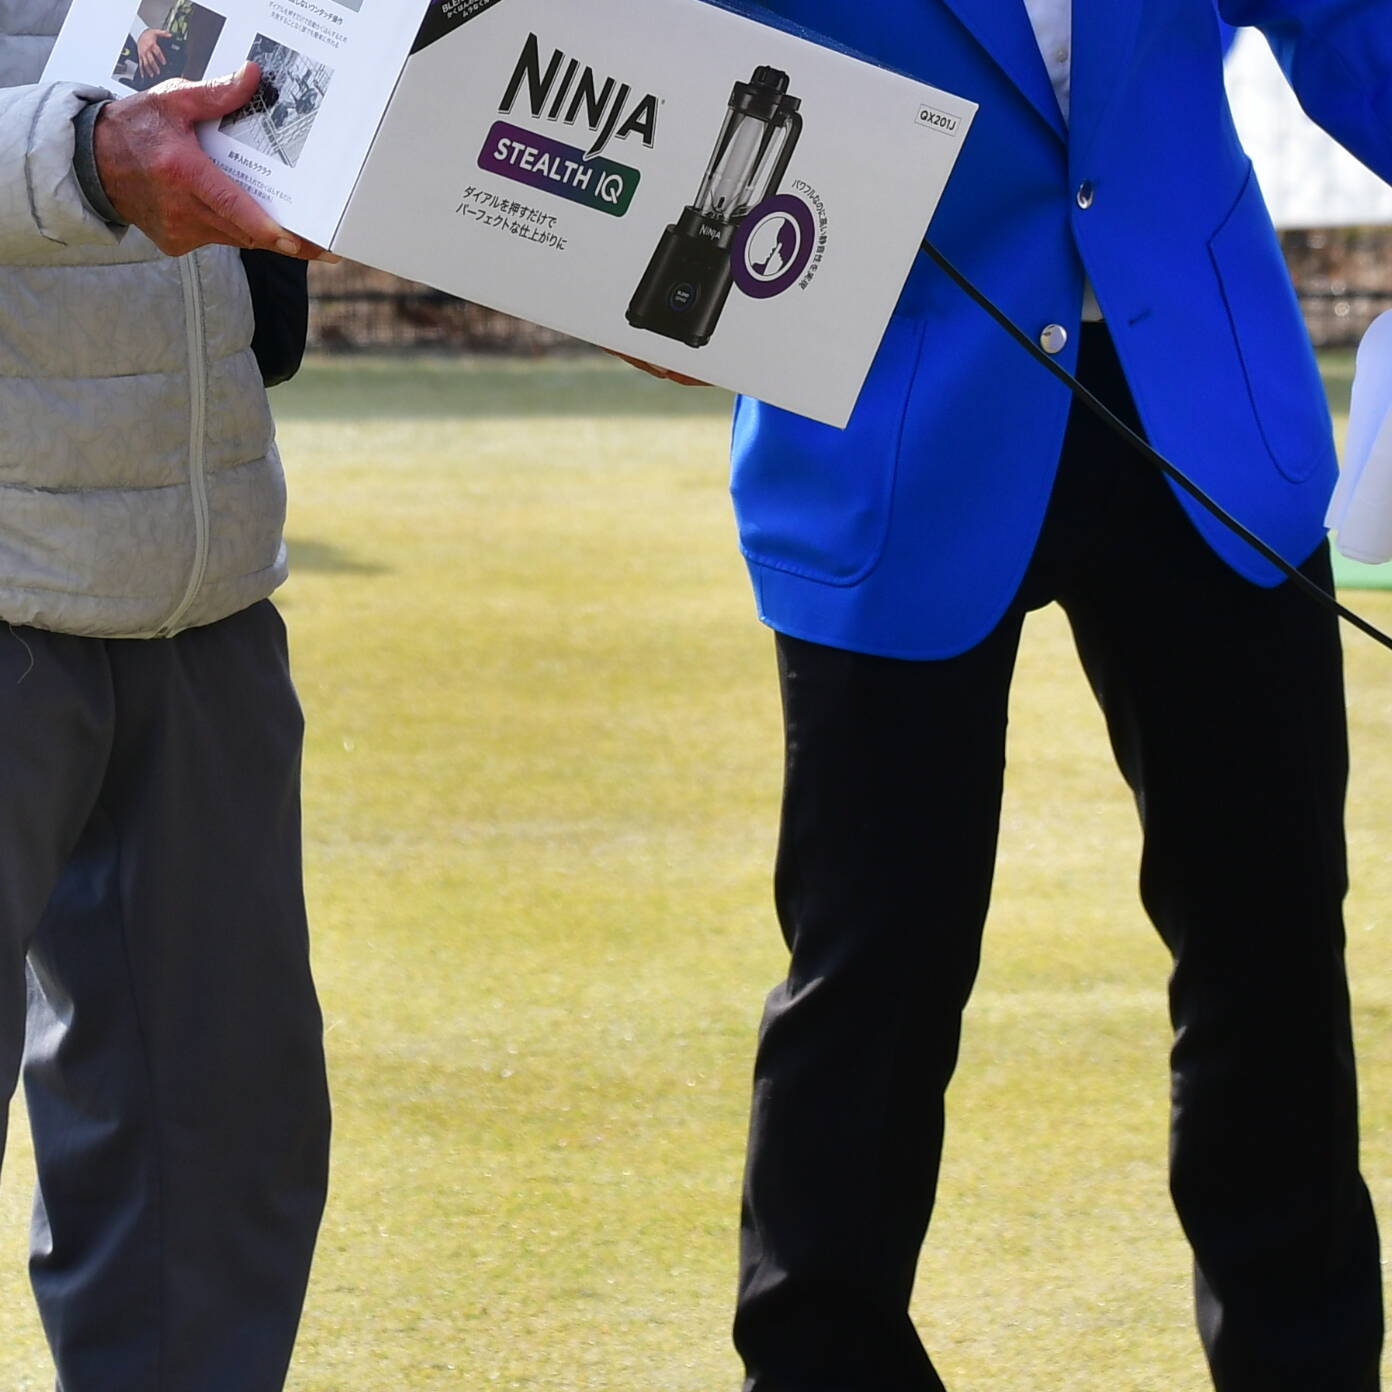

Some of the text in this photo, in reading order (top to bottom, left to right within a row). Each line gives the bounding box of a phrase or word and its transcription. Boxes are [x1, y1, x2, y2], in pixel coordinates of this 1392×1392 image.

[498, 32, 658, 160] NINJA
[919, 110, 956, 131] QX201J
[493, 138, 624, 205] STEALTH IQ
[456, 202, 568, 250] パーフェクトな仕上がりに
[463, 185, 557, 228] ダイアルを押すだけで
[699, 223, 721, 240] NINJA
